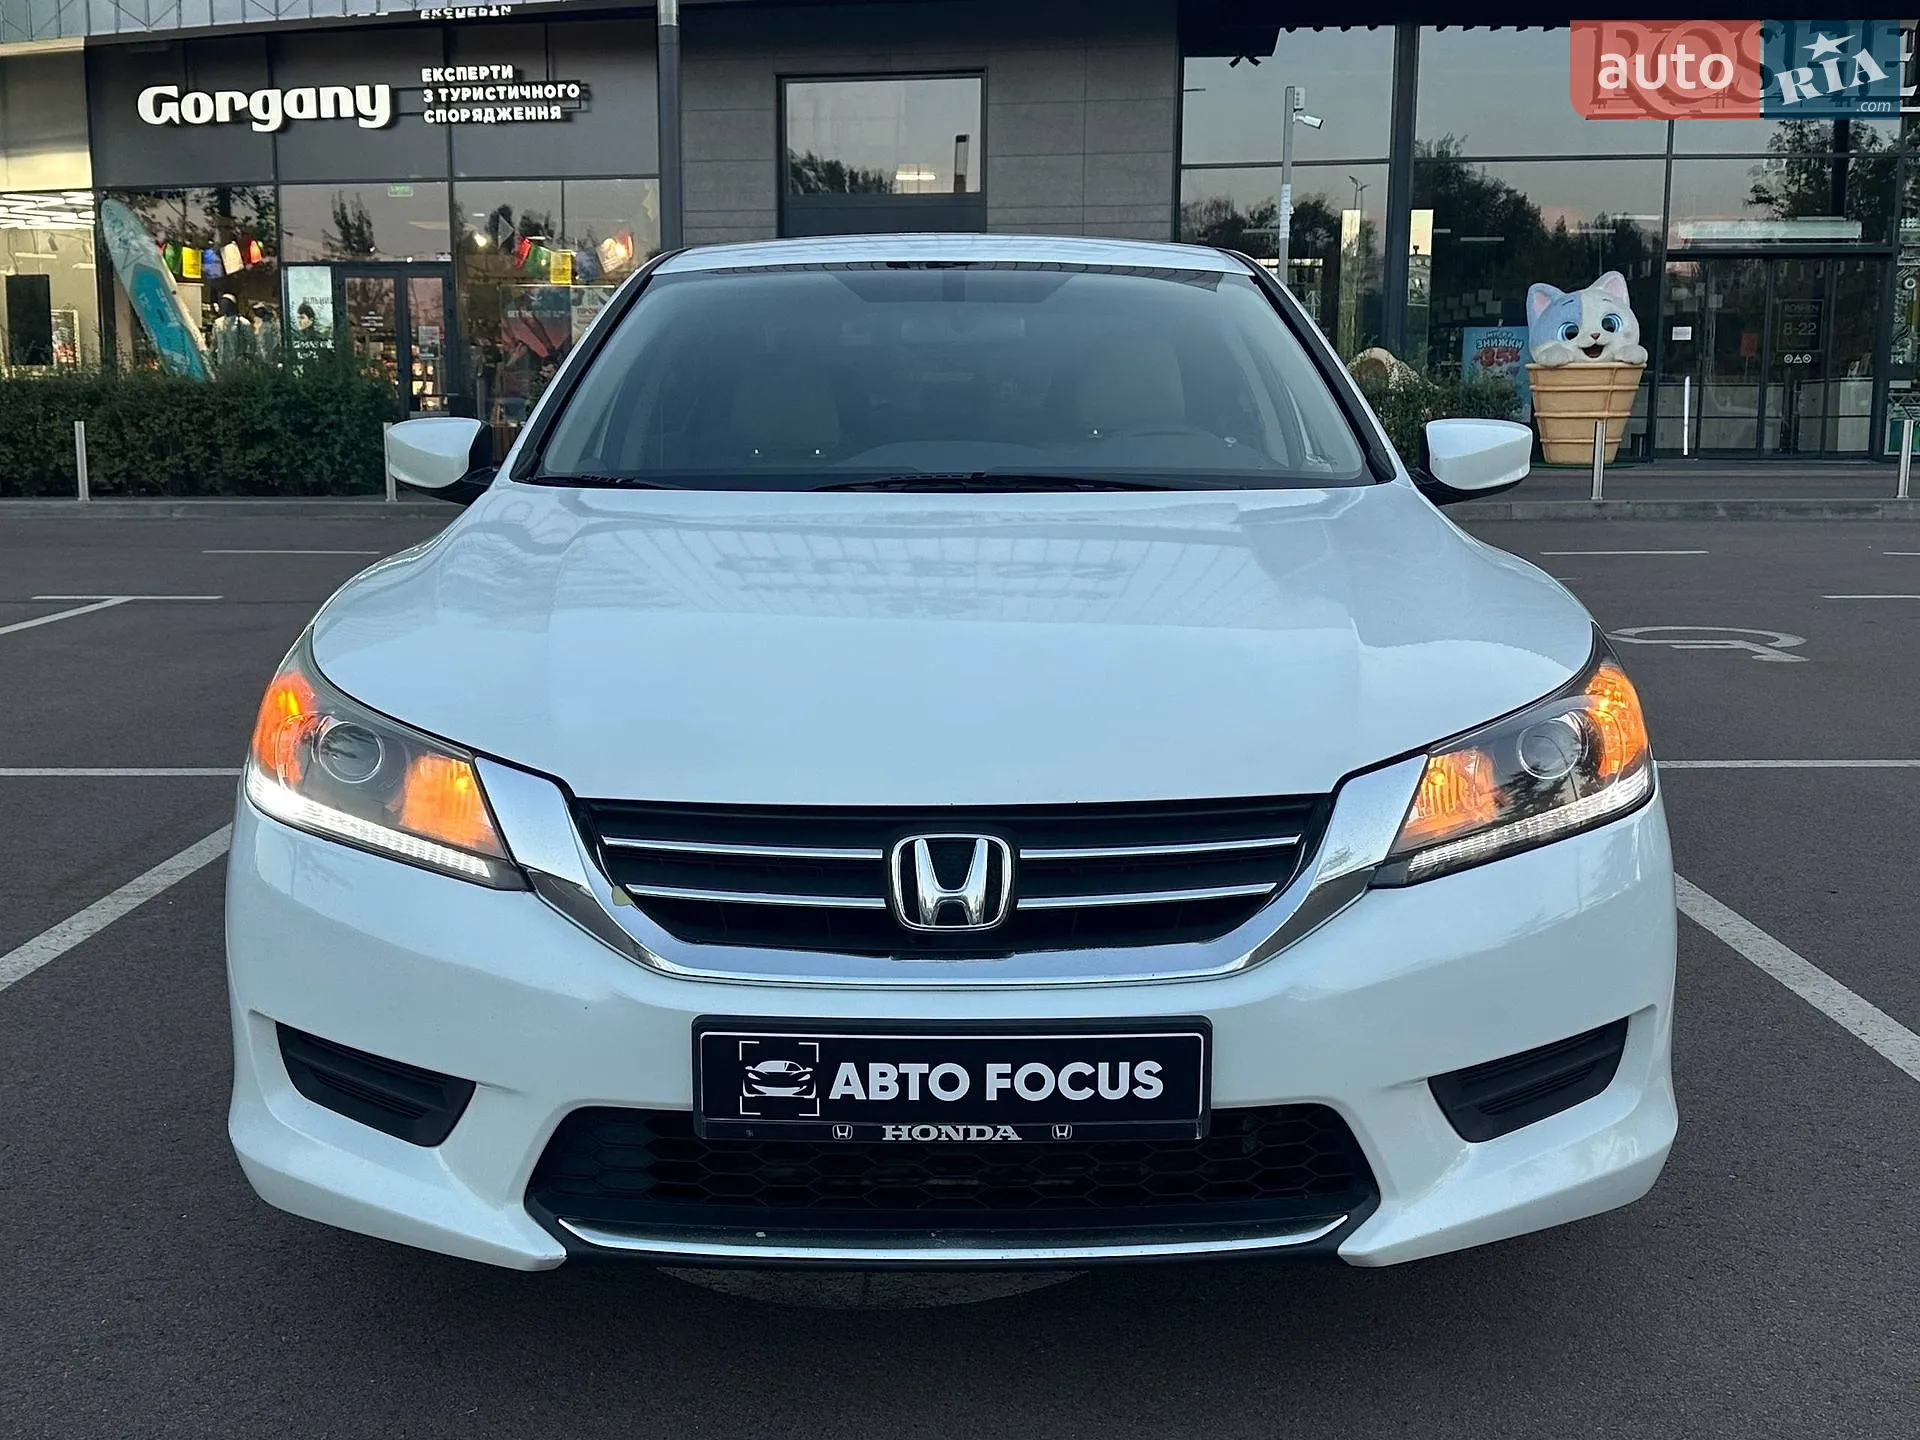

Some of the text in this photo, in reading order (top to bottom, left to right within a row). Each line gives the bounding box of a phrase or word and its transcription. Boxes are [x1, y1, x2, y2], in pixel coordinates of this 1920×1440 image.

[421, 65, 513, 81] ЕКСПЕРТИ
[438, 83, 580, 102] ТУРИСТИЧНОГО
[137, 84, 391, 132] Gorgany
[423, 106, 561, 123] СПОРЯДЖЕННЯ
[1783, 322, 1817, 336] 8-22
[1476, 338, 1523, 349] ЗНИЖКИ
[986, 1061, 1164, 1101] FOCUS
[882, 1125, 1022, 1141] HONDA
